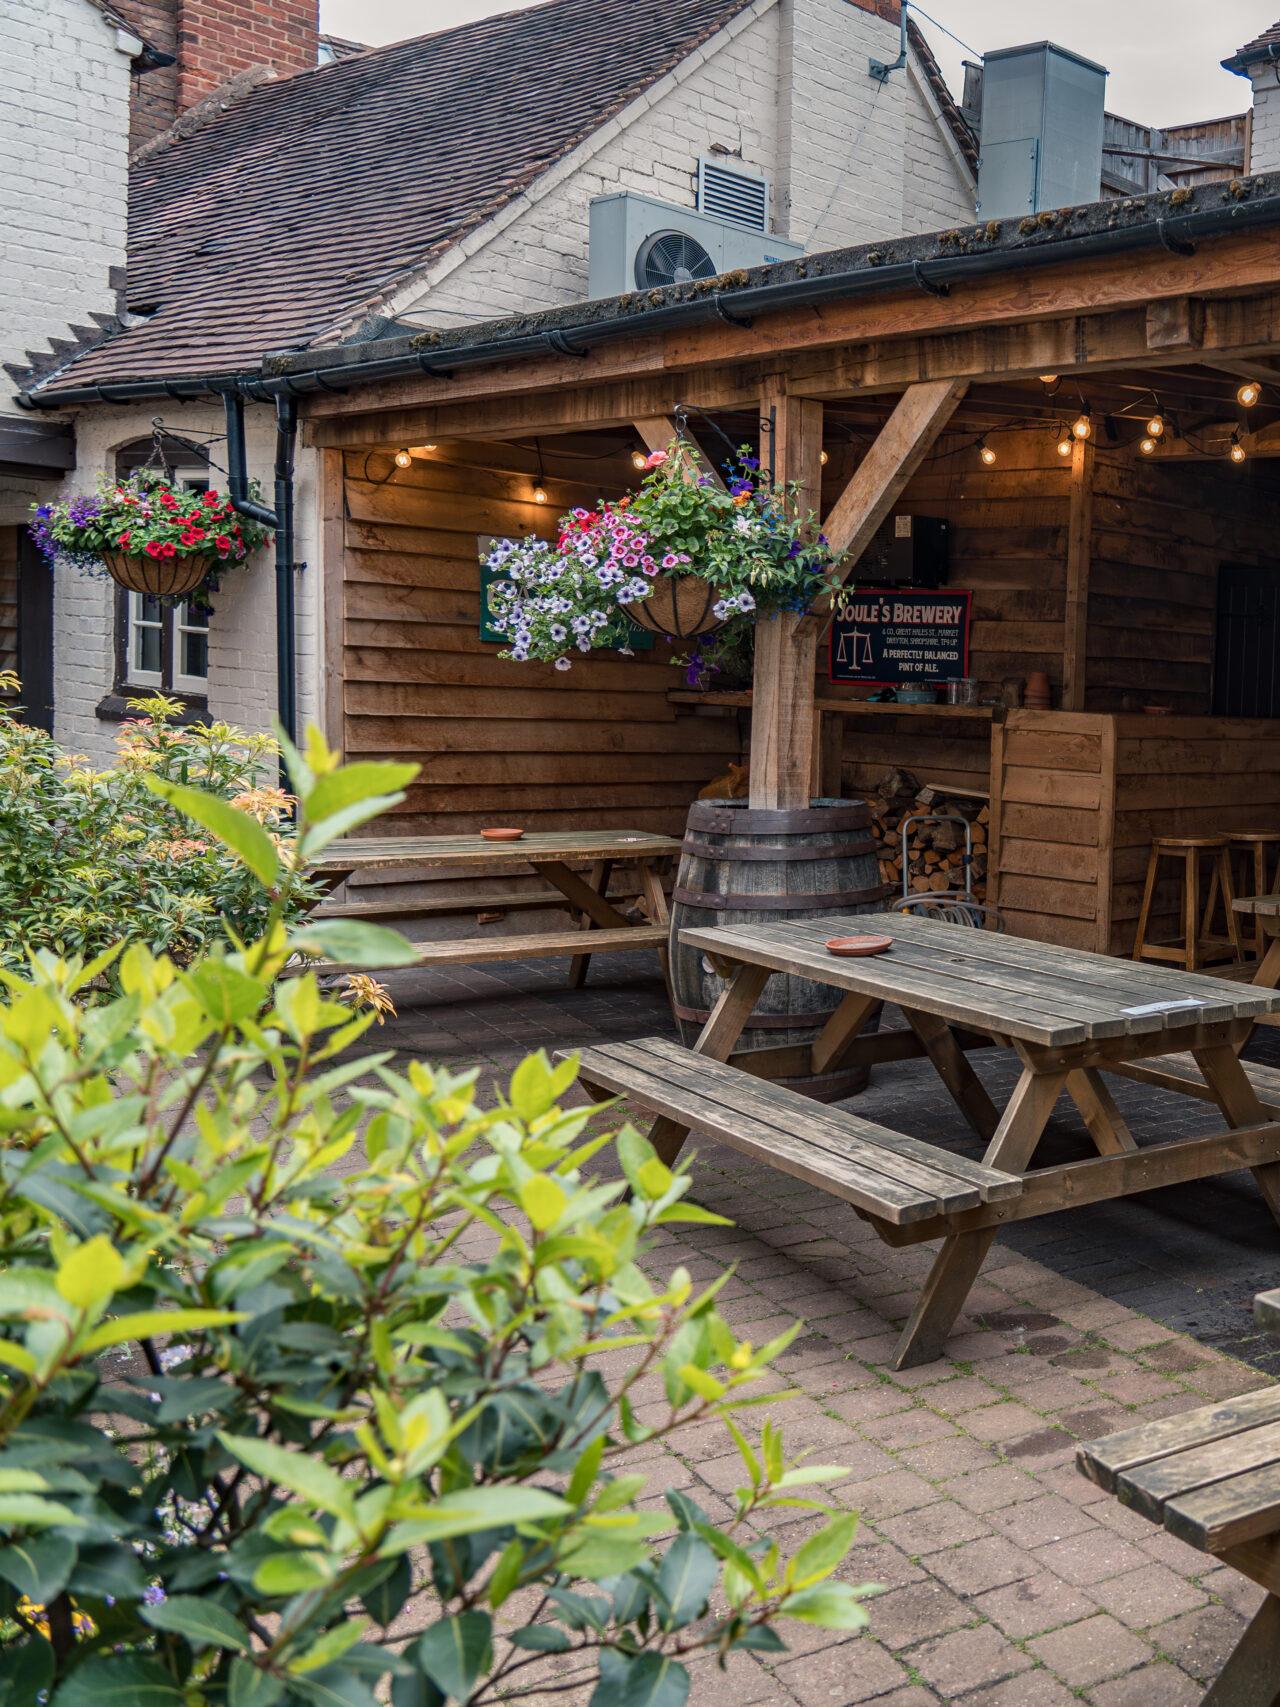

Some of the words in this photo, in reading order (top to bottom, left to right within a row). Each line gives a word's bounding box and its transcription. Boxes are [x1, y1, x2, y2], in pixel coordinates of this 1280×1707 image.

[893, 603, 962, 624] BREWERY
[882, 648, 888, 658] A
[888, 649, 924, 660] PERFECTLY
[924, 650, 959, 661] BALANCED
[898, 662, 914, 672] PINT
[914, 663, 924, 672] OF
